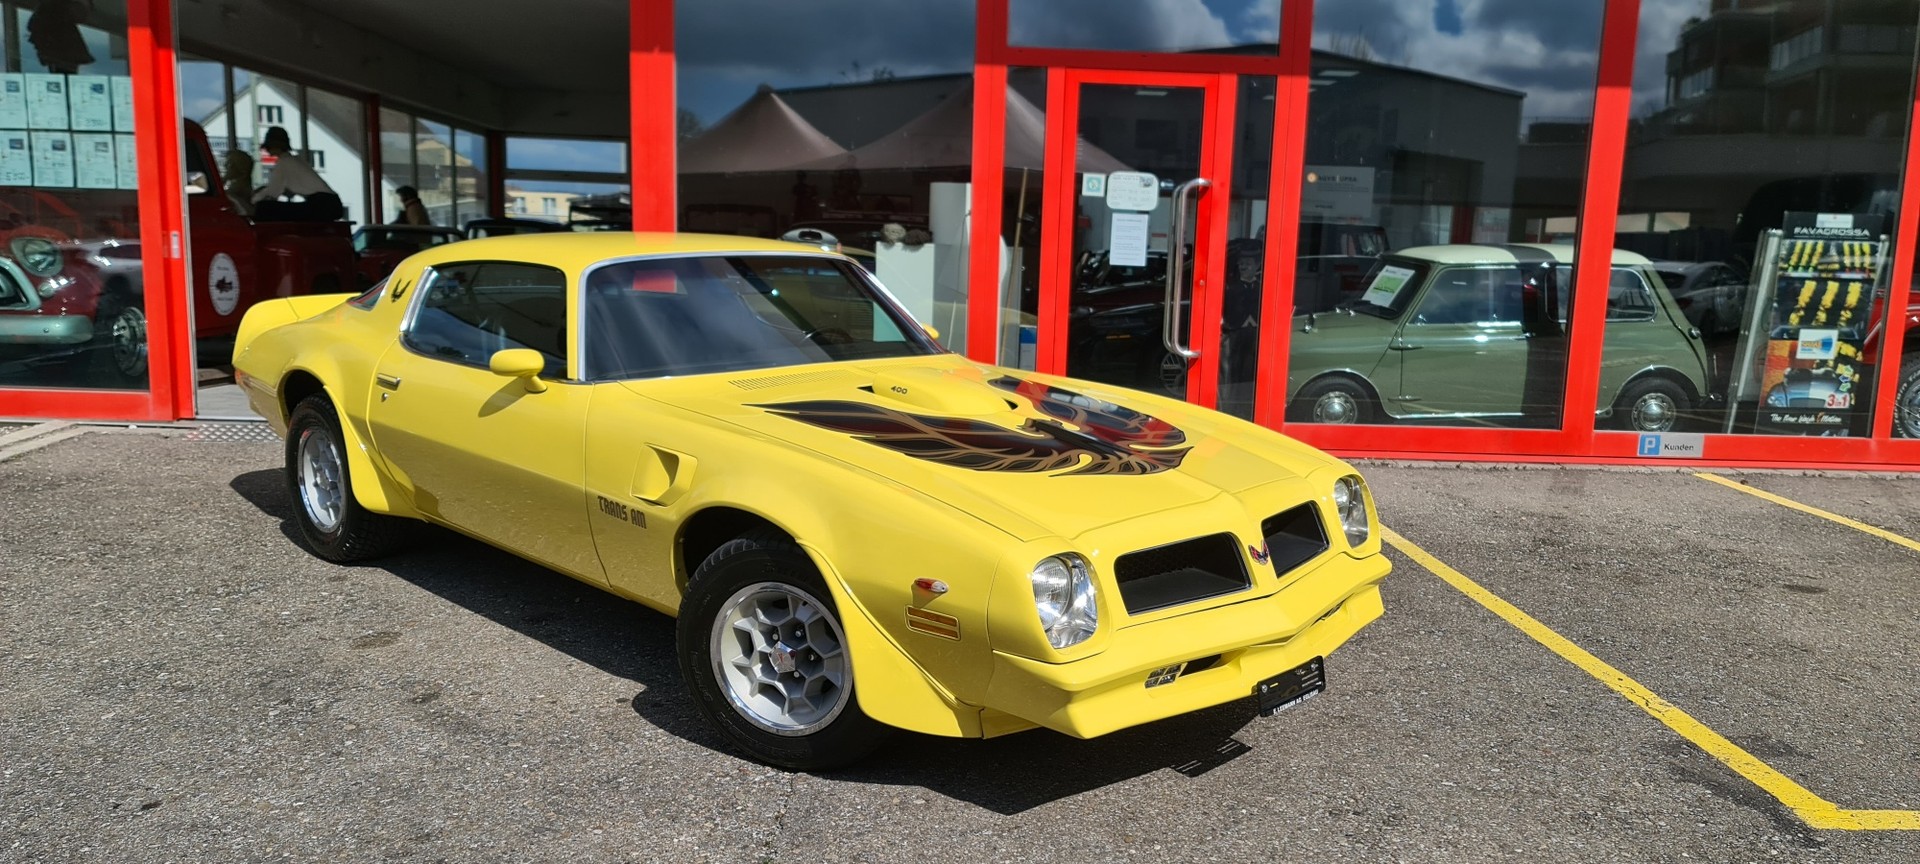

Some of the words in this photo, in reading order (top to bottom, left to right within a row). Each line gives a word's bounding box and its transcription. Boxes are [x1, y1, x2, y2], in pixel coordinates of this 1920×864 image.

[1794, 226, 1870, 236] FAVAGROSSA
[890, 385, 908, 394] 400
[1664, 443, 1694, 451] Kunden
[597, 495, 628, 521] TRANS
[630, 508, 647, 529] AM
